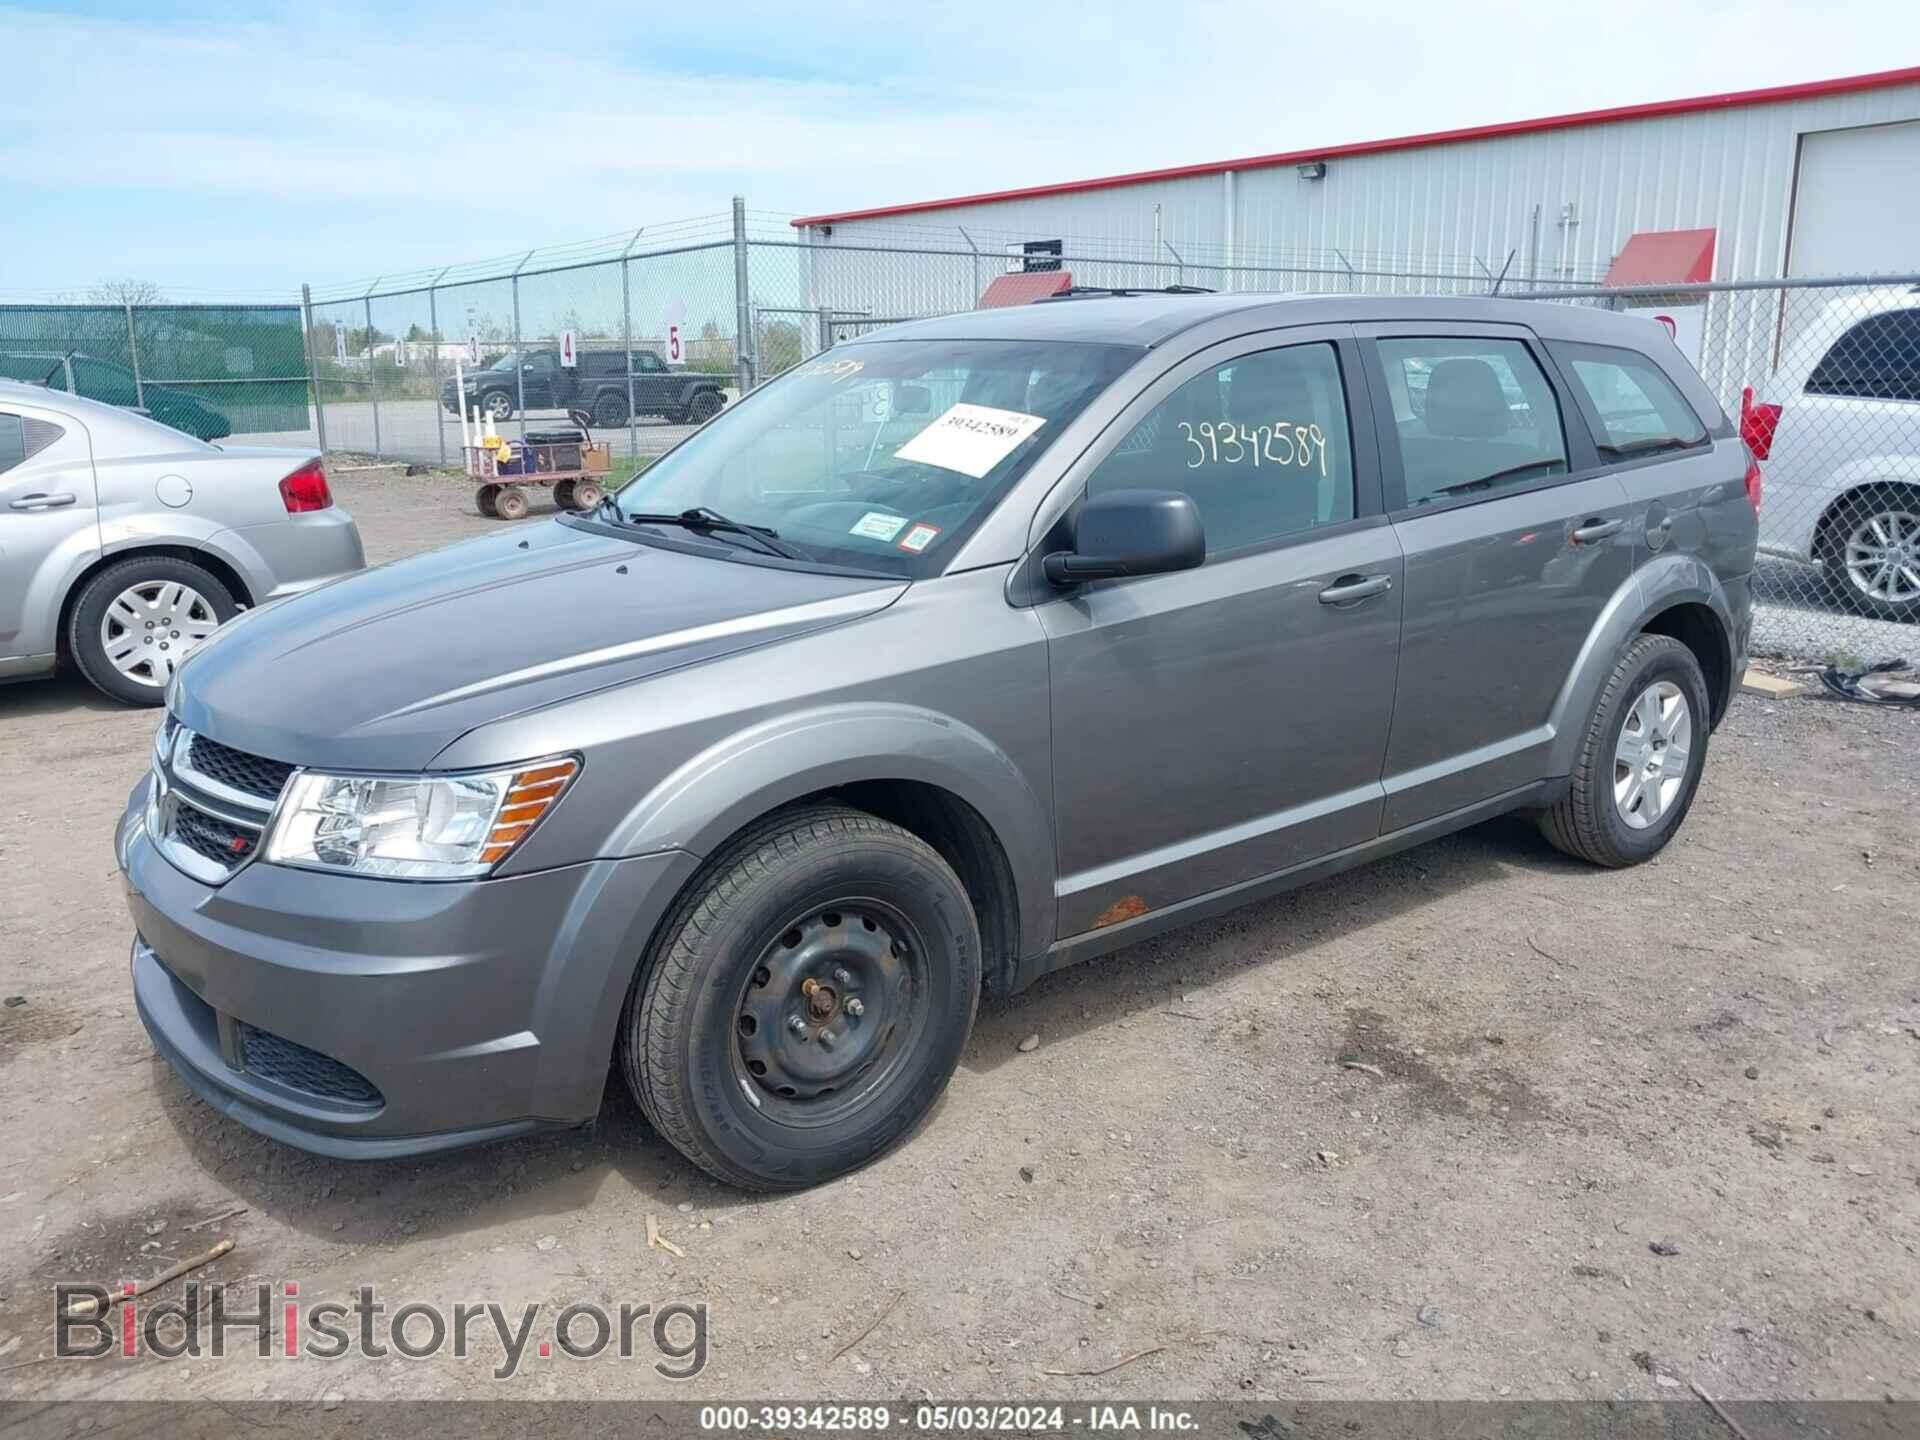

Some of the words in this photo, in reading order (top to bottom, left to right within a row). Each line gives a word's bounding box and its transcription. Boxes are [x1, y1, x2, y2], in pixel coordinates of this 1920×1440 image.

[564, 332, 572, 363] 4
[670, 326, 680, 360] 5
[1177, 421, 1327, 477] 39342589
